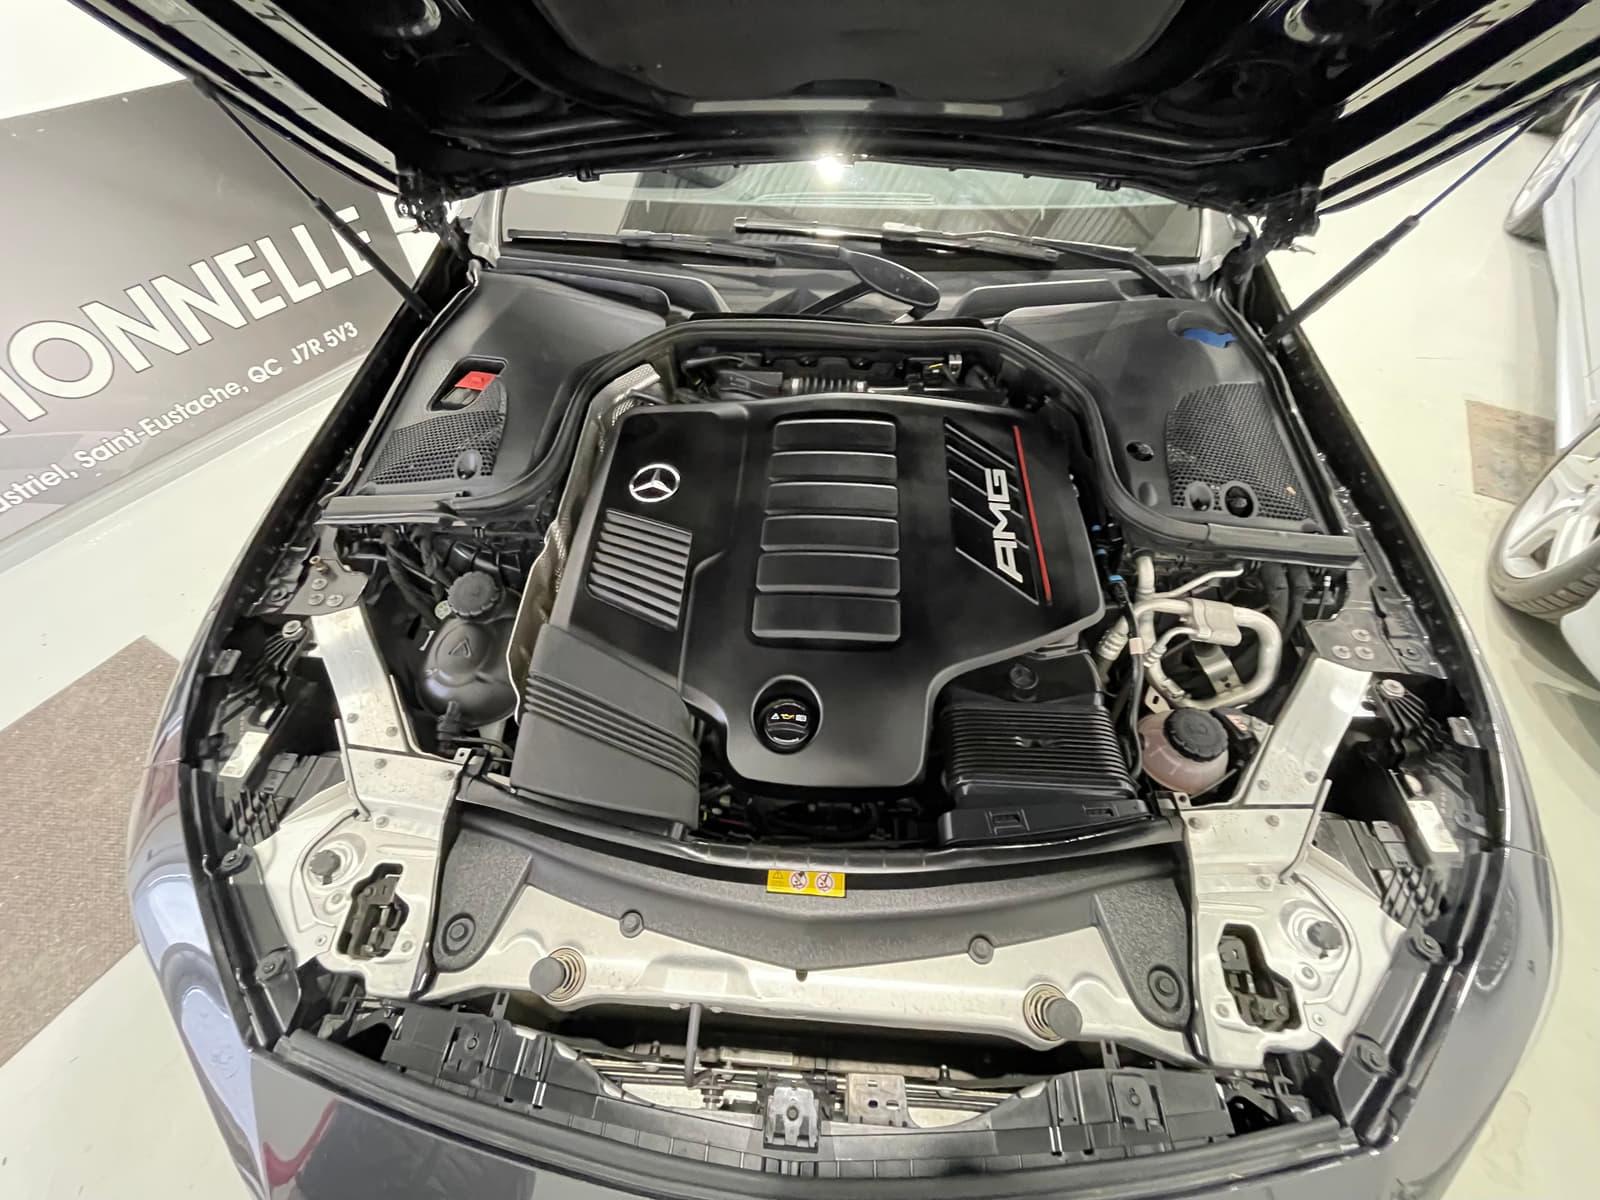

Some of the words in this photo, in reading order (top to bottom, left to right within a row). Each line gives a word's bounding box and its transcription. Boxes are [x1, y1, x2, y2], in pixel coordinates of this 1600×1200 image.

[0, 205, 374, 435] IONNELLE
[74, 382, 249, 468] Saint-Eustache,
[247, 358, 283, 383] QC
[290, 338, 325, 365] J7R
[322, 321, 358, 347] 5V3
[984, 467, 1024, 584] AMG
